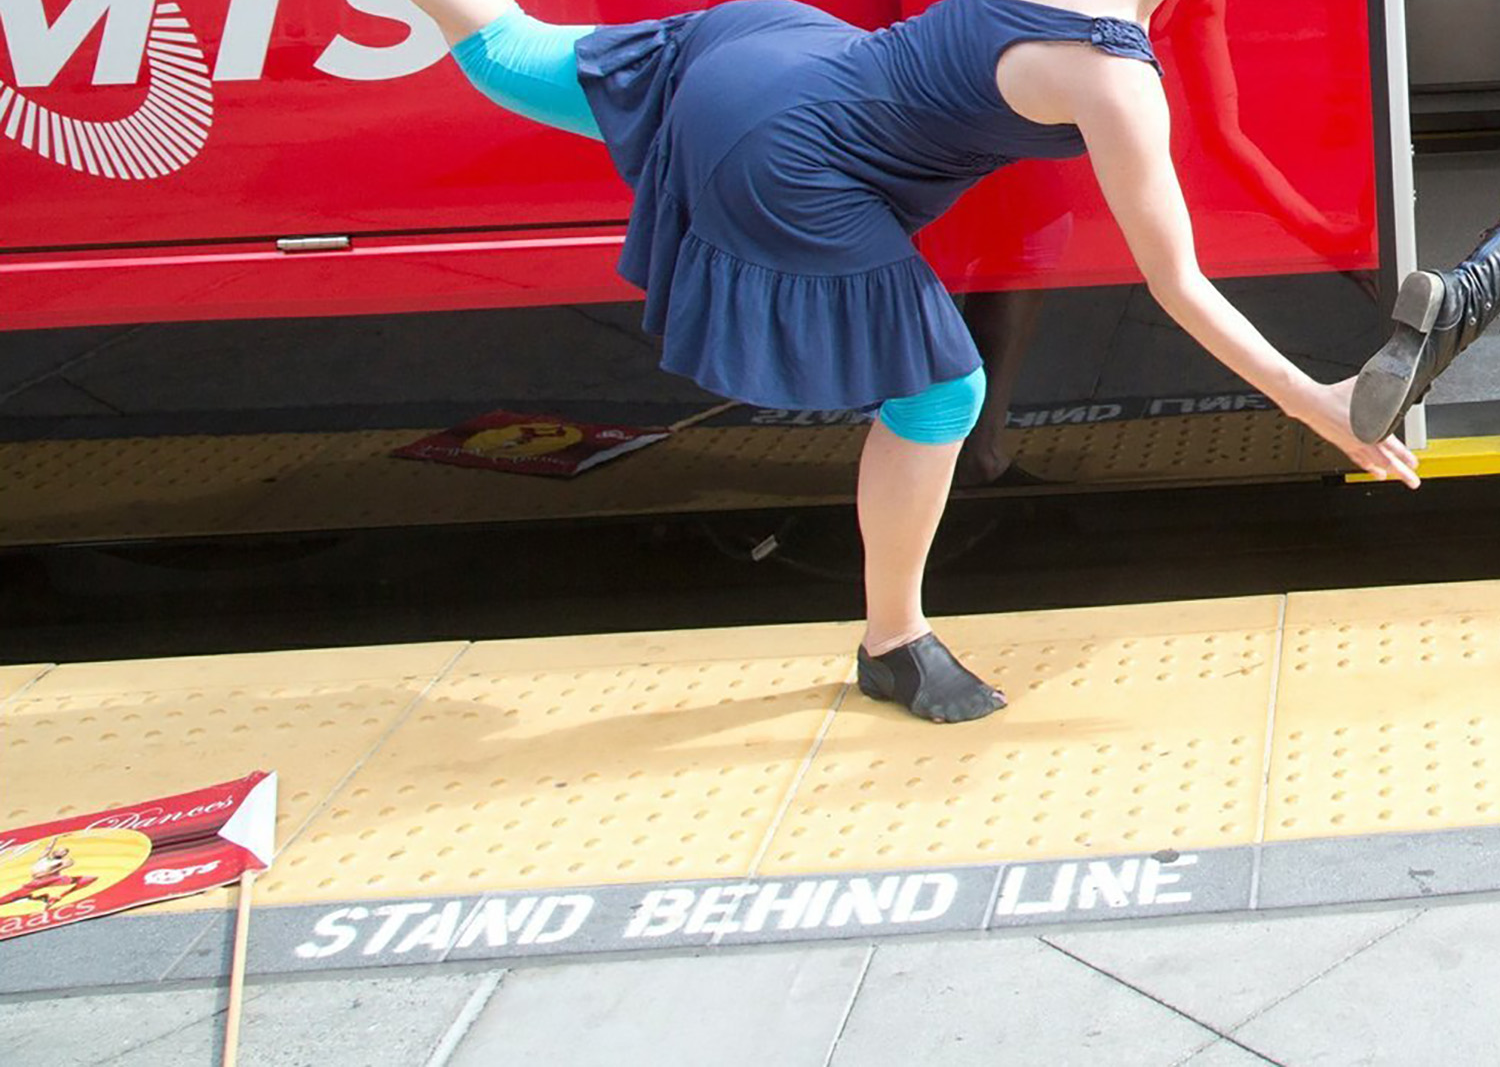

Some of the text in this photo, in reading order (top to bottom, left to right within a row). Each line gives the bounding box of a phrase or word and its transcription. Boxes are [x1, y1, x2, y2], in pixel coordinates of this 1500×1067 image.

[294, 853, 1199, 959] STAND BEHIND LINE
